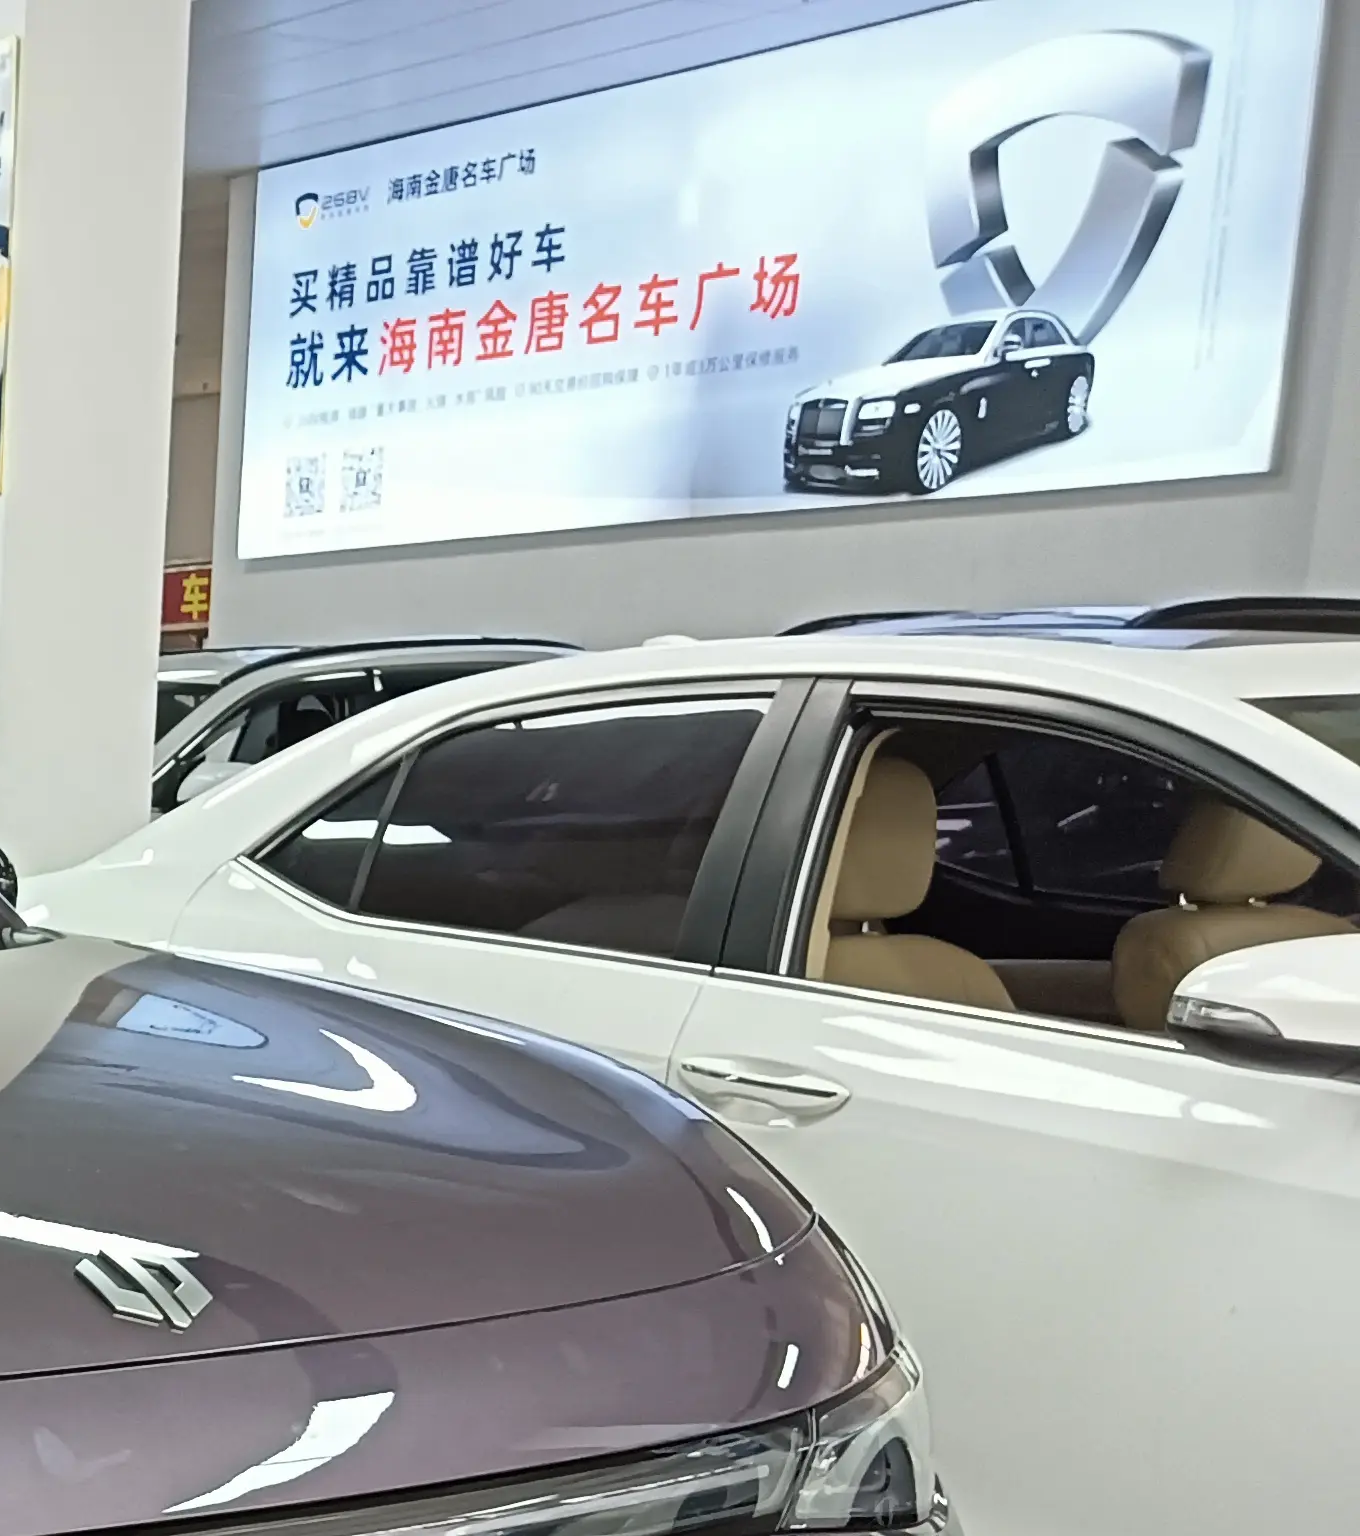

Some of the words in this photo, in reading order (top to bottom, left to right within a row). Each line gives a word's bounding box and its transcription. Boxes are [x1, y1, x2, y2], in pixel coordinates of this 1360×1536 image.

[387, 148, 536, 204] 海南金唐名车广场
[289, 223, 567, 318] 买精品靠谱好车
[286, 252, 800, 389] 就来海南金唐名车广场
[180, 573, 209, 620] 车
